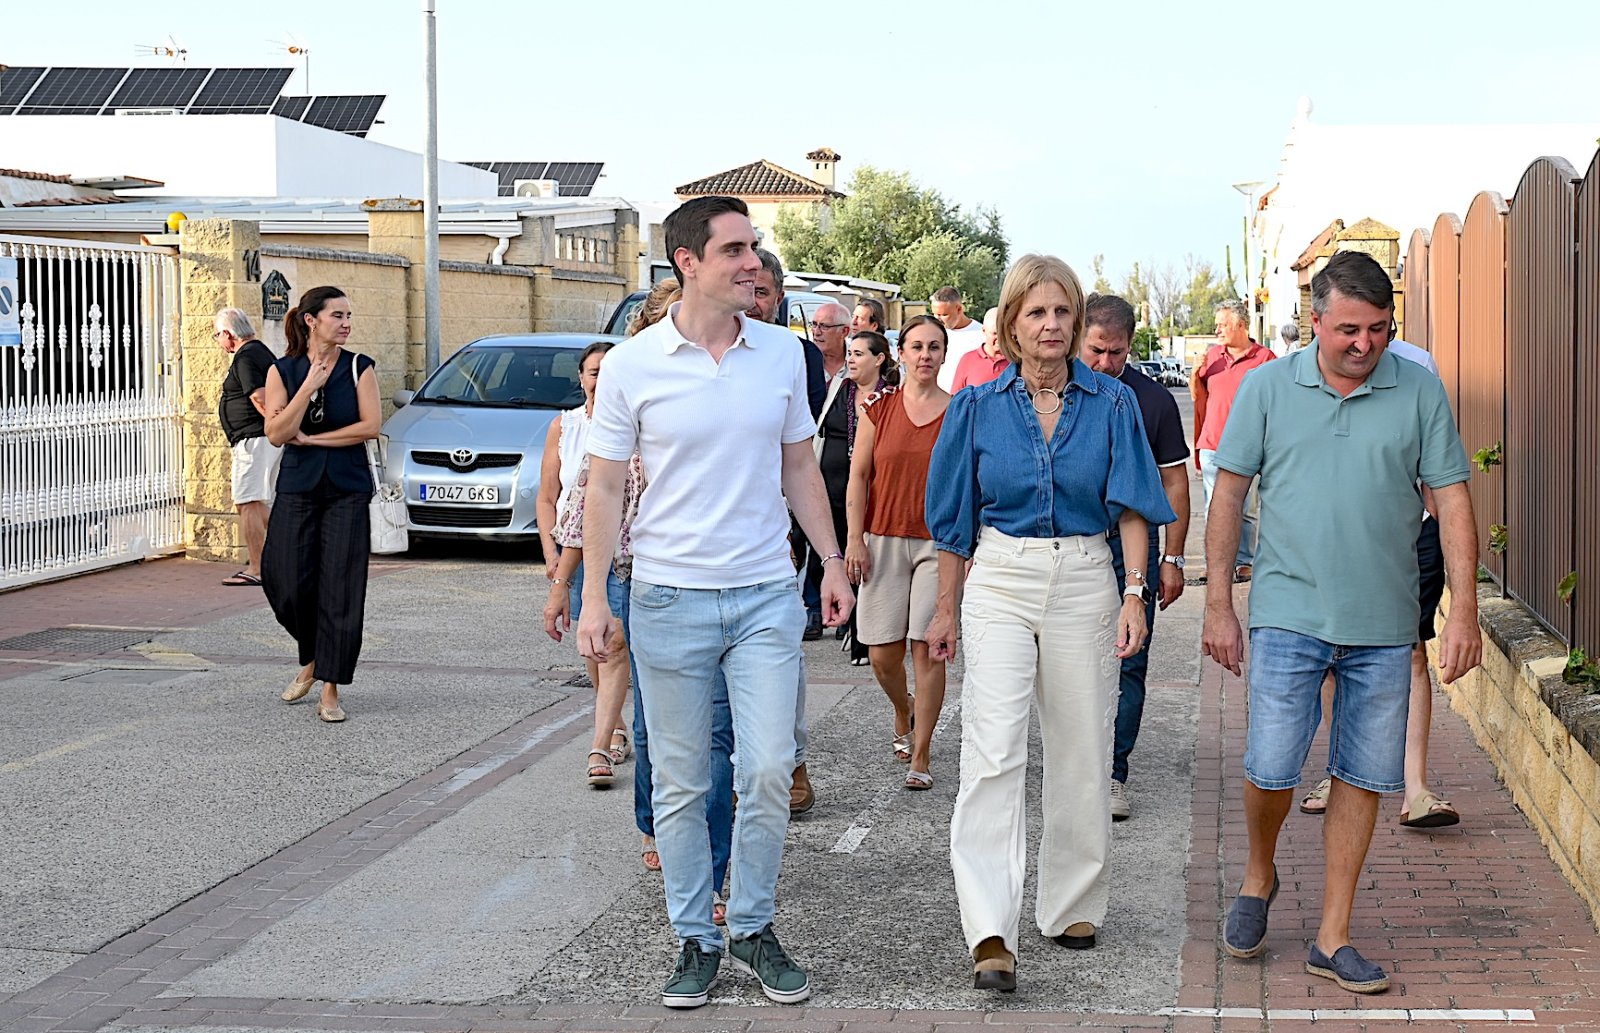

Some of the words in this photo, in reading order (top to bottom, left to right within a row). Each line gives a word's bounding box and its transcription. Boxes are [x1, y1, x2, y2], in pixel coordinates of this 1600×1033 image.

[243, 249, 262, 282] 14
[428, 486, 463, 500] 7047
[468, 487, 495, 501] GKS
